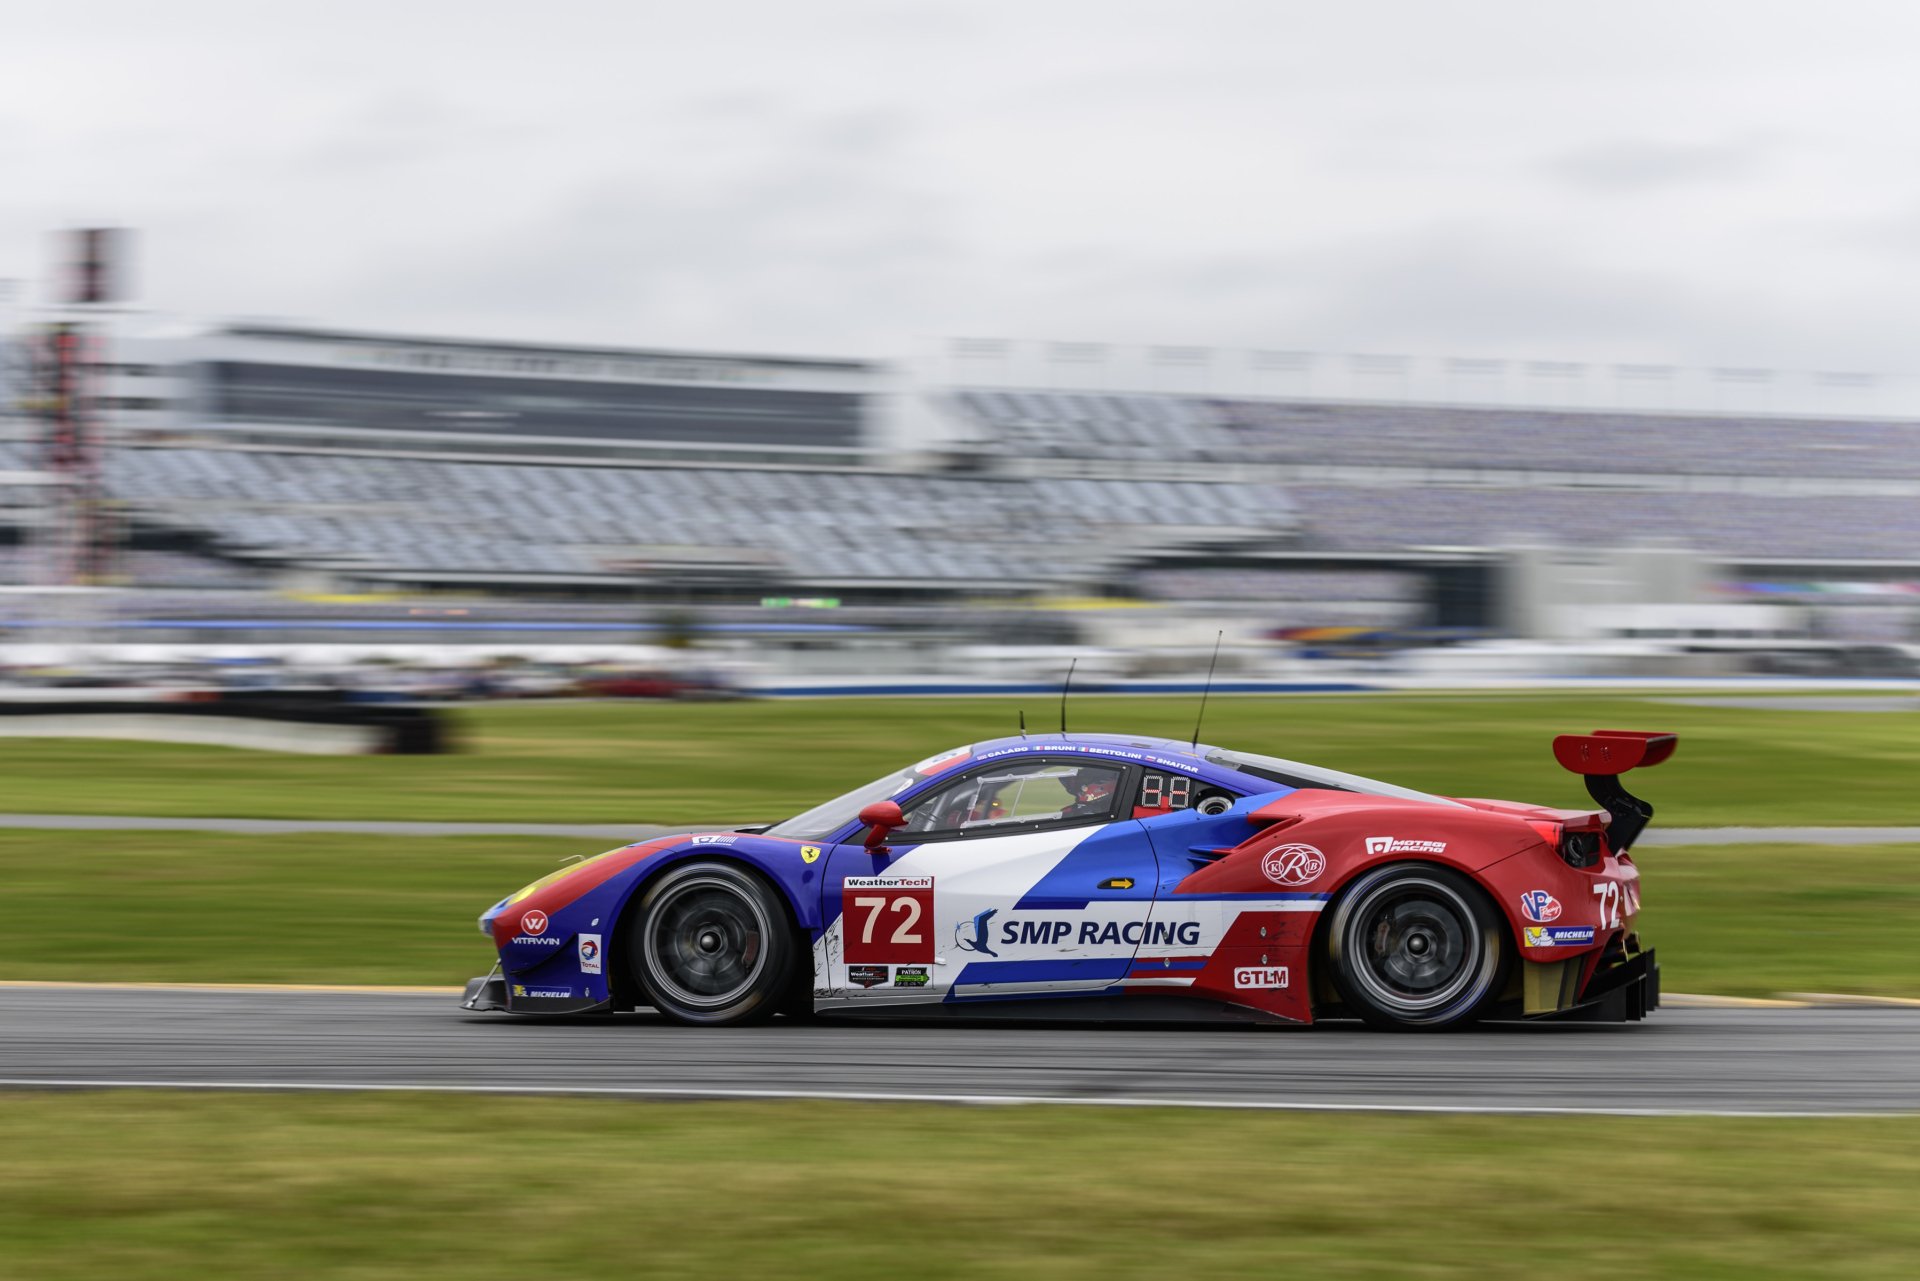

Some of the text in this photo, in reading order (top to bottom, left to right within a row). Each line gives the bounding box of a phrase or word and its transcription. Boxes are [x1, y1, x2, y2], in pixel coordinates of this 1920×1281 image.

[987, 746, 1028, 758] CALADO
[1088, 747, 1142, 760] BERTOLINI
[1156, 758, 1199, 773] SHAITAR
[1390, 845, 1445, 853] RACING
[1393, 840, 1447, 848] MOTEGI
[1521, 890, 1550, 921] VP
[1593, 881, 1620, 930] 72
[855, 896, 922, 943] 72
[1000, 921, 1200, 945] SMP RACING
[1554, 930, 1595, 939] MICHELIN
[1237, 970, 1286, 985] GTLM
